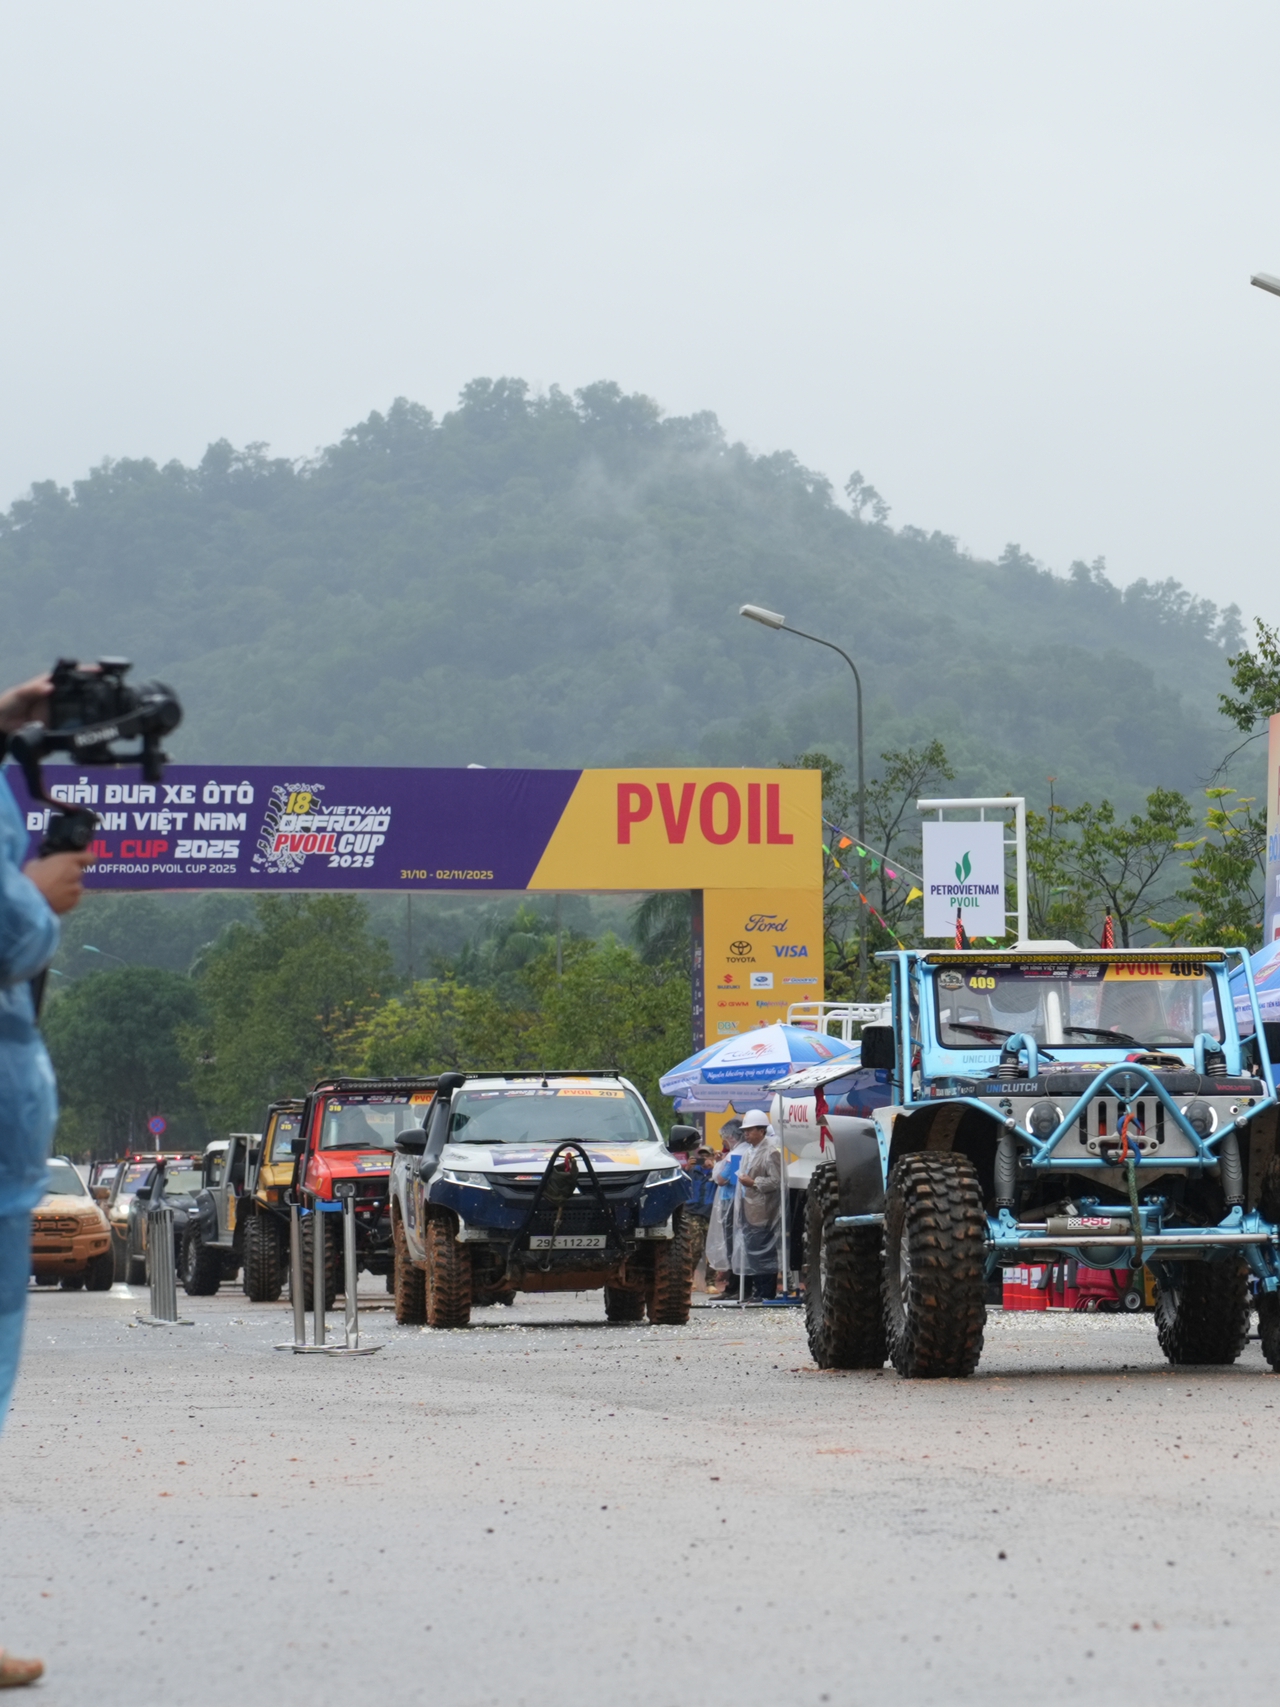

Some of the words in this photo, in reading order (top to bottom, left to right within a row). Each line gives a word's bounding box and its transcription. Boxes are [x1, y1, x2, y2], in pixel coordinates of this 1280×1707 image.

[51, 777, 99, 804] GIẢI
[105, 785, 156, 804] ĐUA
[162, 785, 196, 804] XE
[203, 780, 254, 804] ÔTÔ
[286, 792, 312, 814] 18
[321, 806, 391, 815] VIETNAM
[616, 781, 794, 845] PVOIL
[133, 808, 188, 835] VIỆT
[193, 812, 247, 831] NAM
[279, 815, 390, 832] OFFROAD
[120, 840, 168, 858] CUP
[174, 840, 240, 858] 2025
[273, 833, 337, 853] PVOIL
[338, 834, 385, 853] CUP
[327, 855, 374, 867] 2025
[99, 864, 149, 874] OFFROAD
[152, 864, 183, 874] PVOIL
[186, 864, 206, 874] CUP
[209, 864, 236, 874] 2025
[400, 870, 427, 879] 31/10
[436, 870, 493, 879] 02/11/2025
[930, 884, 999, 895] PETROVIETNAM
[950, 897, 979, 907] PVOIL
[744, 914, 789, 932] Ford
[773, 945, 808, 957] VISA
[1115, 963, 1163, 975] PVOIL
[1170, 963, 1204, 976] 409
[968, 977, 996, 989] 409
[963, 1055, 1000, 1064] UNICLUT
[986, 1083, 1038, 1093] UNICLUTCH
[788, 1104, 809, 1123] PVOIL
[1081, 1217, 1111, 1226] PSC
